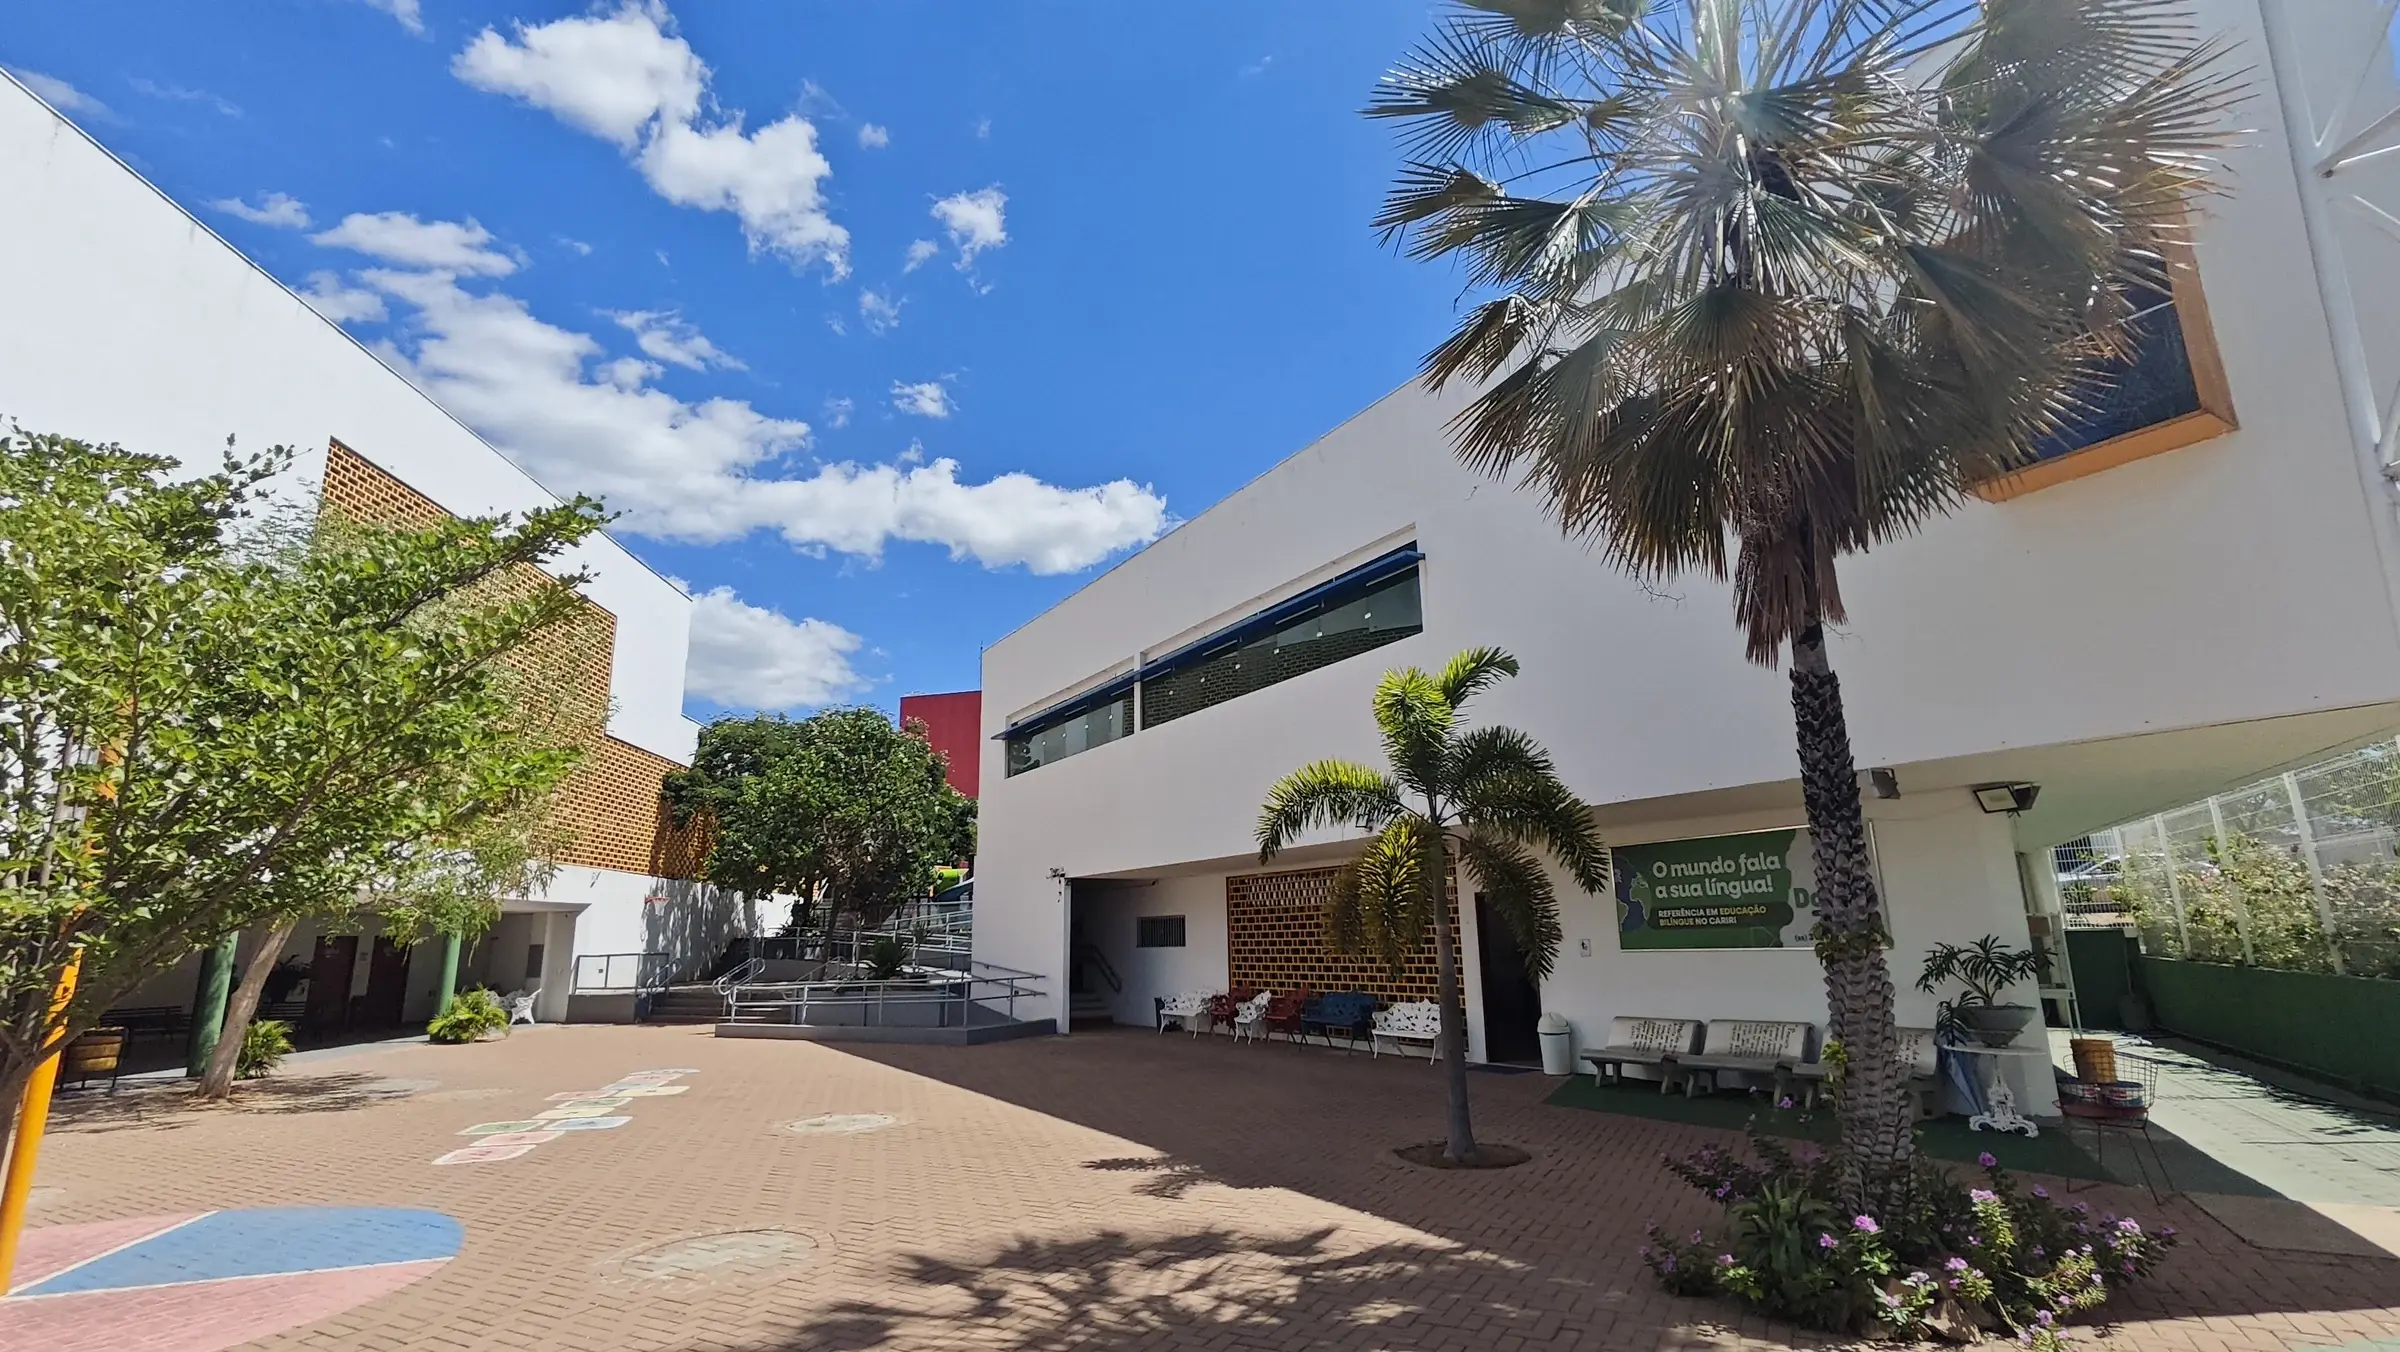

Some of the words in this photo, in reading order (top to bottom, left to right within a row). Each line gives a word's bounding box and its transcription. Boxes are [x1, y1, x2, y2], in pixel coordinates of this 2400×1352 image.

[1652, 861, 1667, 878] O
[1670, 855, 1736, 877] mundo
[1738, 851, 1781, 876] fala
[1655, 885, 1668, 898] a
[1670, 882, 1703, 898] sua
[1704, 874, 1773, 899] língua!
[1658, 907, 1705, 918] REFERÊNCIA
[1706, 907, 1718, 916] EM
[1719, 903, 1767, 916] EDUCAÇÃO
[1659, 917, 1694, 927] BILÍNGUE
[1695, 917, 1707, 925] NO
[1708, 916, 1737, 925] CARIRI
